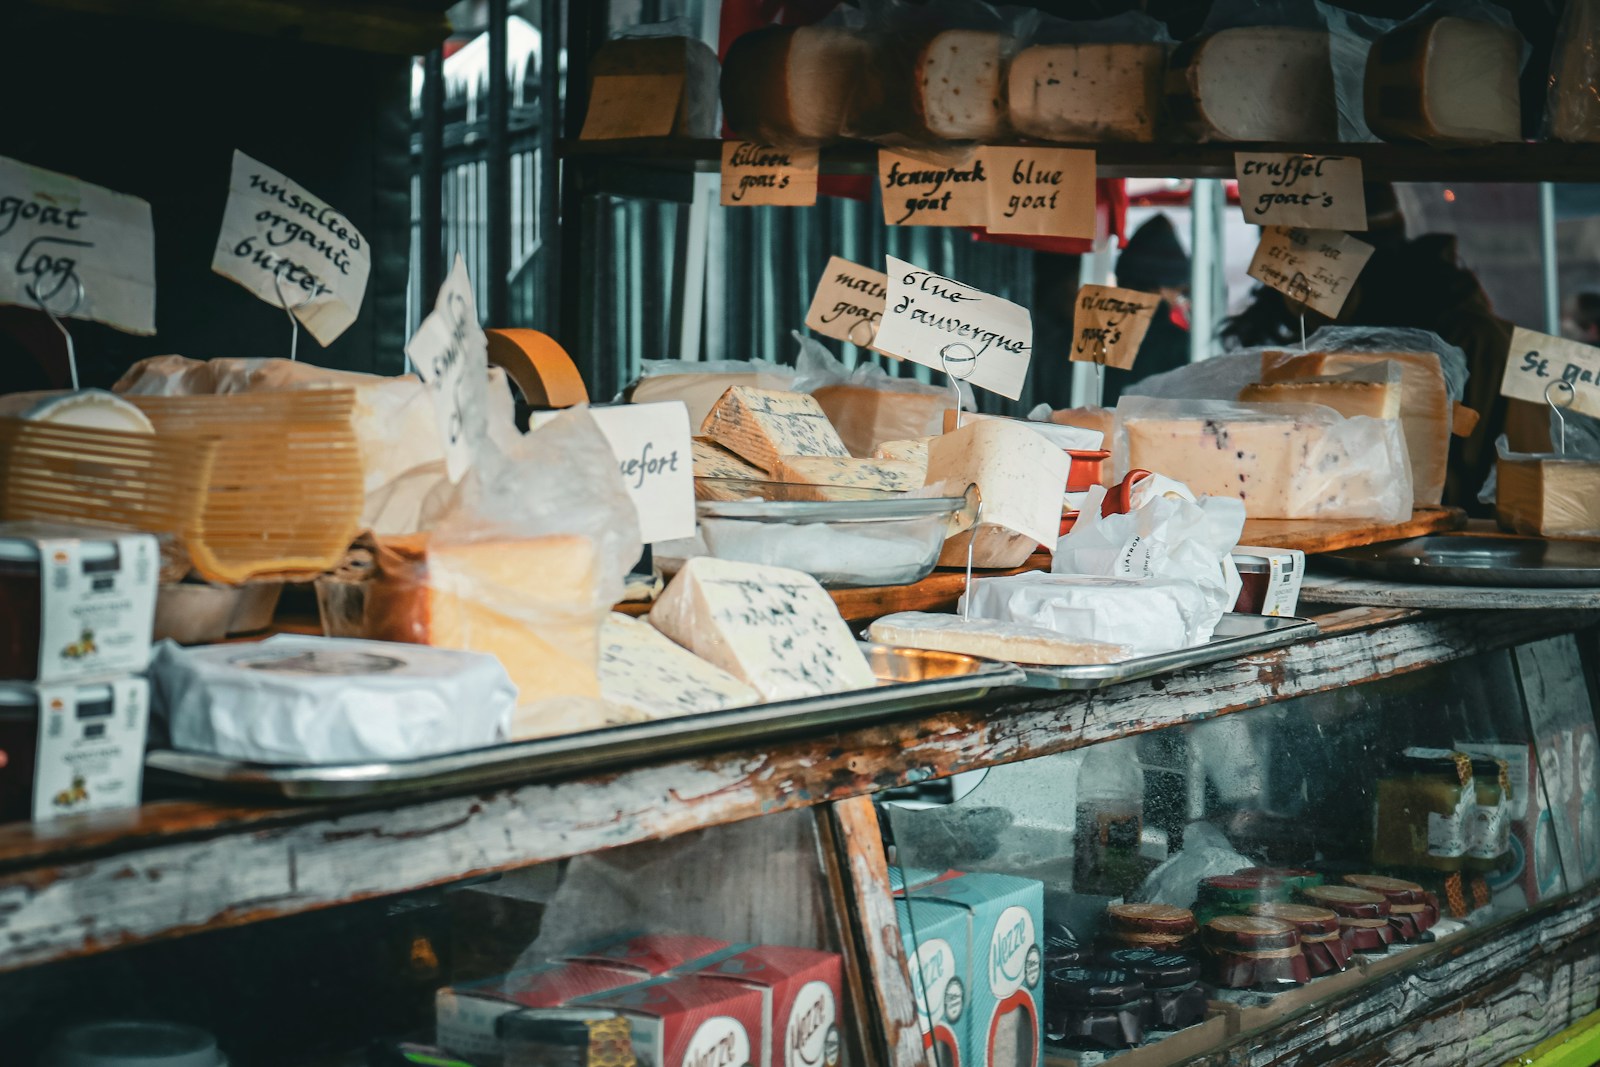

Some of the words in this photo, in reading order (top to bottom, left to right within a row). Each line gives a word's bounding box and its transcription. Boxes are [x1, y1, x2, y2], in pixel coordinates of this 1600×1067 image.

[728, 142, 792, 167] killeen
[1243, 155, 1343, 187] truffel
[1012, 159, 1065, 185] blue
[0, 196, 89, 237] goat
[249, 174, 361, 251] unsalted
[896, 191, 952, 225] goat
[1003, 190, 1060, 218] goat
[1254, 191, 1333, 215] goat's
[255, 210, 351, 275] organic
[15, 236, 95, 301] log
[234, 235, 333, 297] butter
[902, 270, 985, 303] blue
[893, 295, 1033, 363] d'auvergne
[1520, 350, 1550, 378] St
[992, 916, 1026, 985] Mezze
